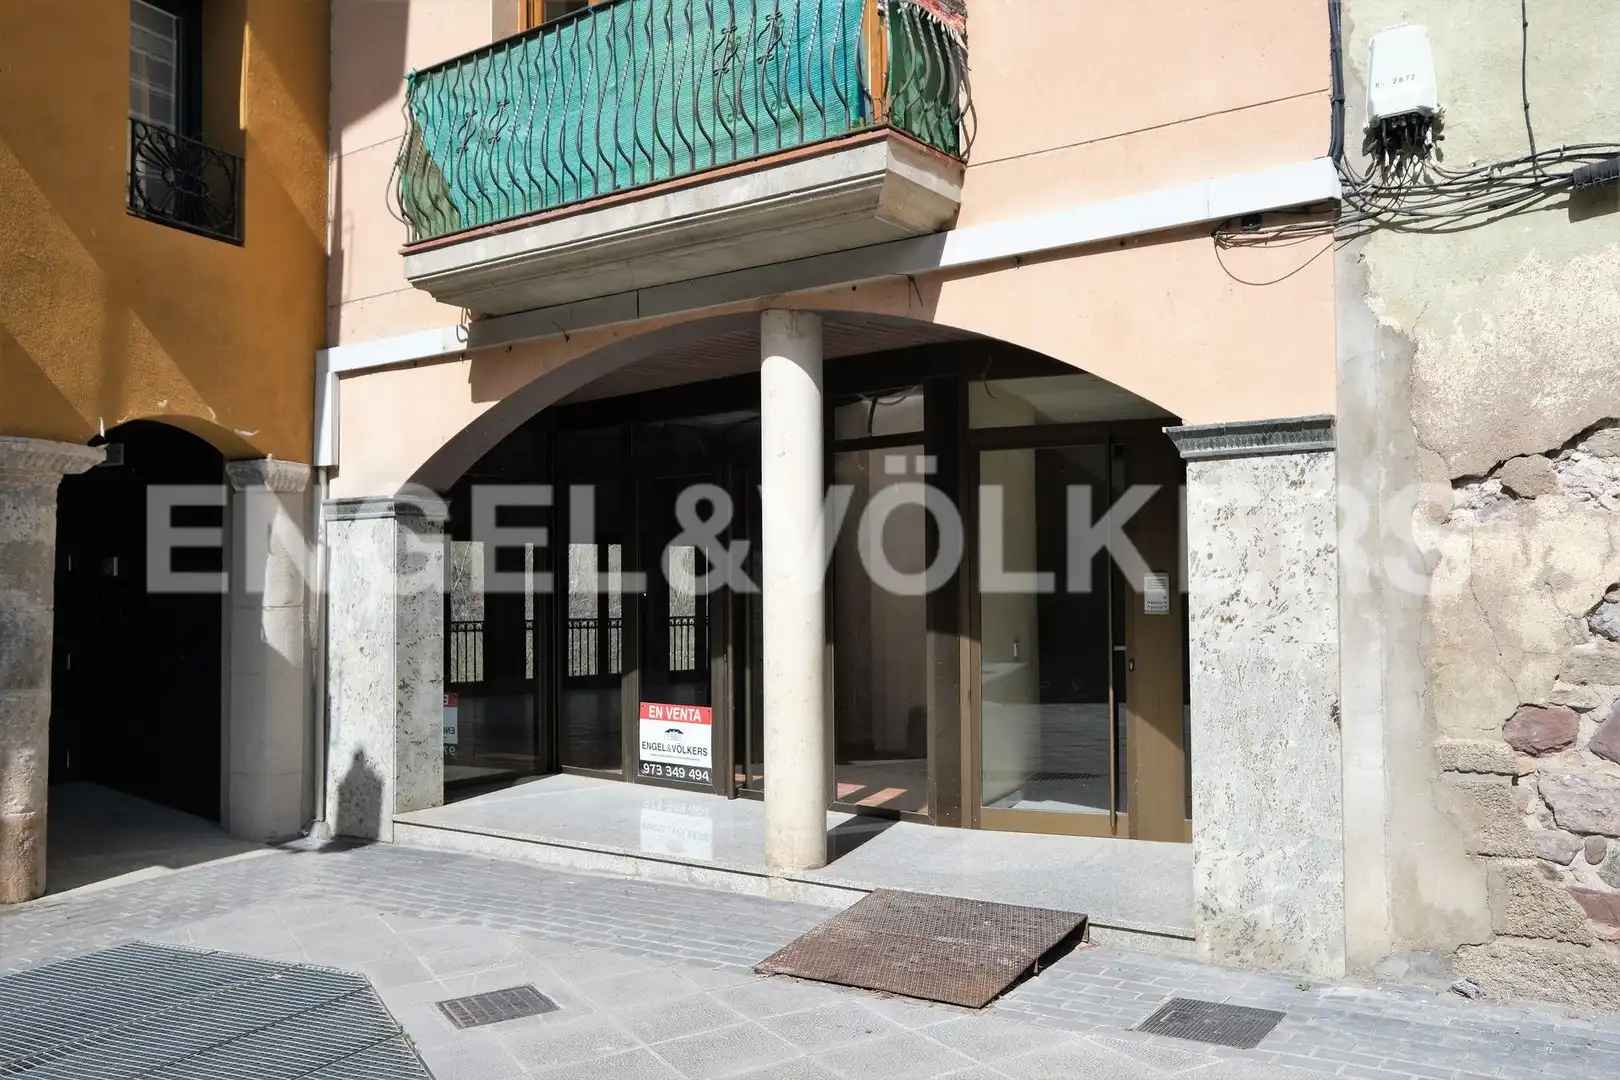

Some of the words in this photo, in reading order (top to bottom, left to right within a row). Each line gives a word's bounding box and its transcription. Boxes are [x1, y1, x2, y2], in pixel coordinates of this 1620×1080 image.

[648, 705, 663, 719] EN
[666, 707, 701, 722] VENTA
[641, 741, 708, 757] ENGEL&VÖLKERS
[643, 763, 662, 776] 973
[666, 765, 686, 778] 349
[689, 768, 709, 781] 494
